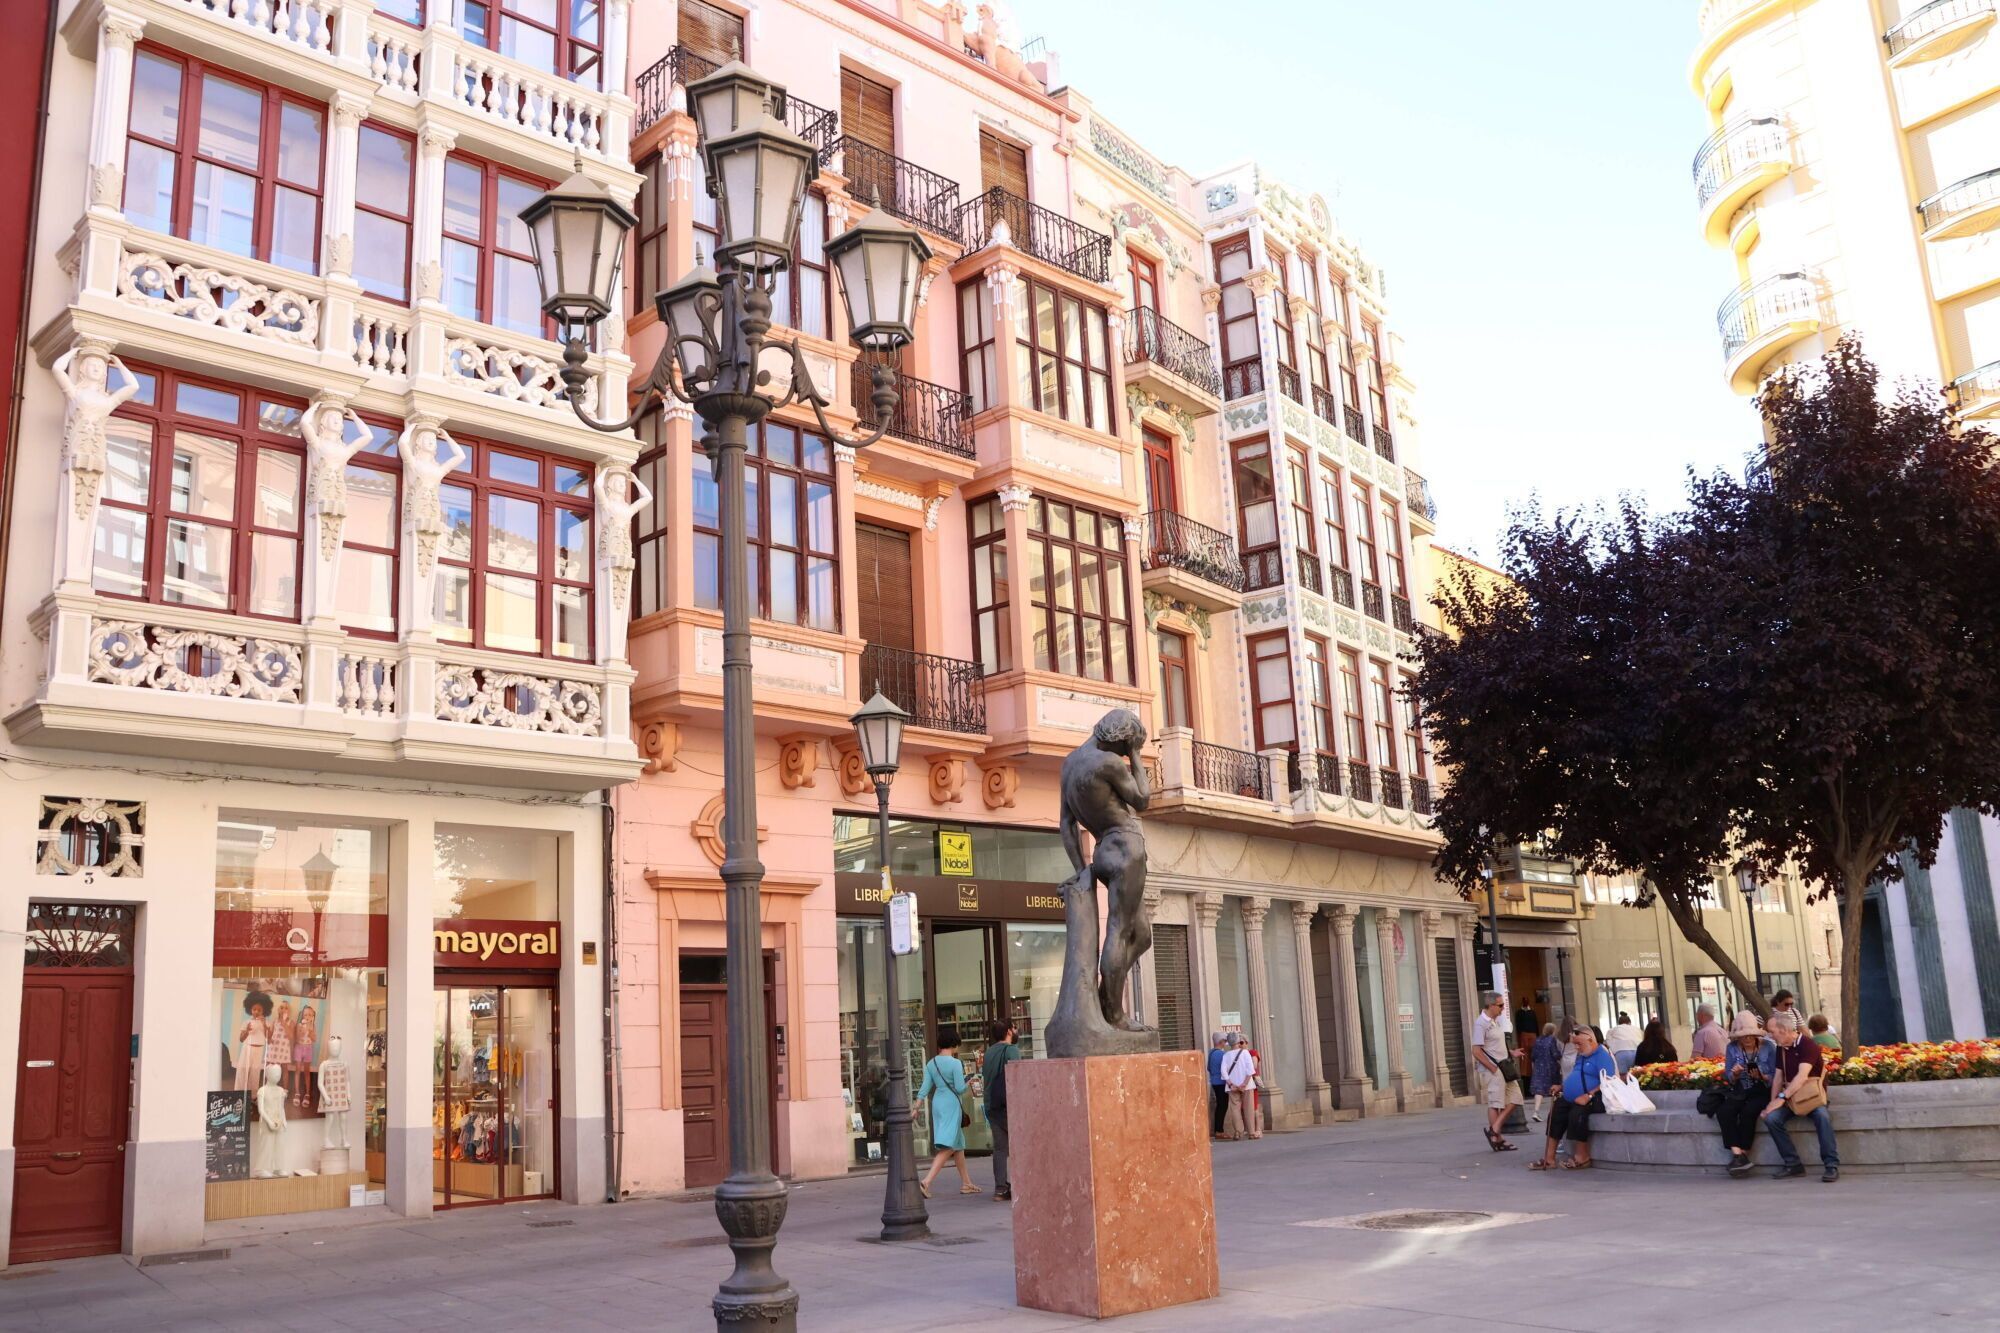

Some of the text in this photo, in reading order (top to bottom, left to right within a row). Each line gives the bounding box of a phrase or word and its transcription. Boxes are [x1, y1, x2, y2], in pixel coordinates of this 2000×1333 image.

[945, 859, 968, 869] Nobel
[84, 872, 94, 884] 3
[960, 900, 977, 908] Nobel
[433, 927, 557, 961] mayoral
[210, 1099, 223, 1110] ICE
[206, 1104, 233, 1120] CREAM
